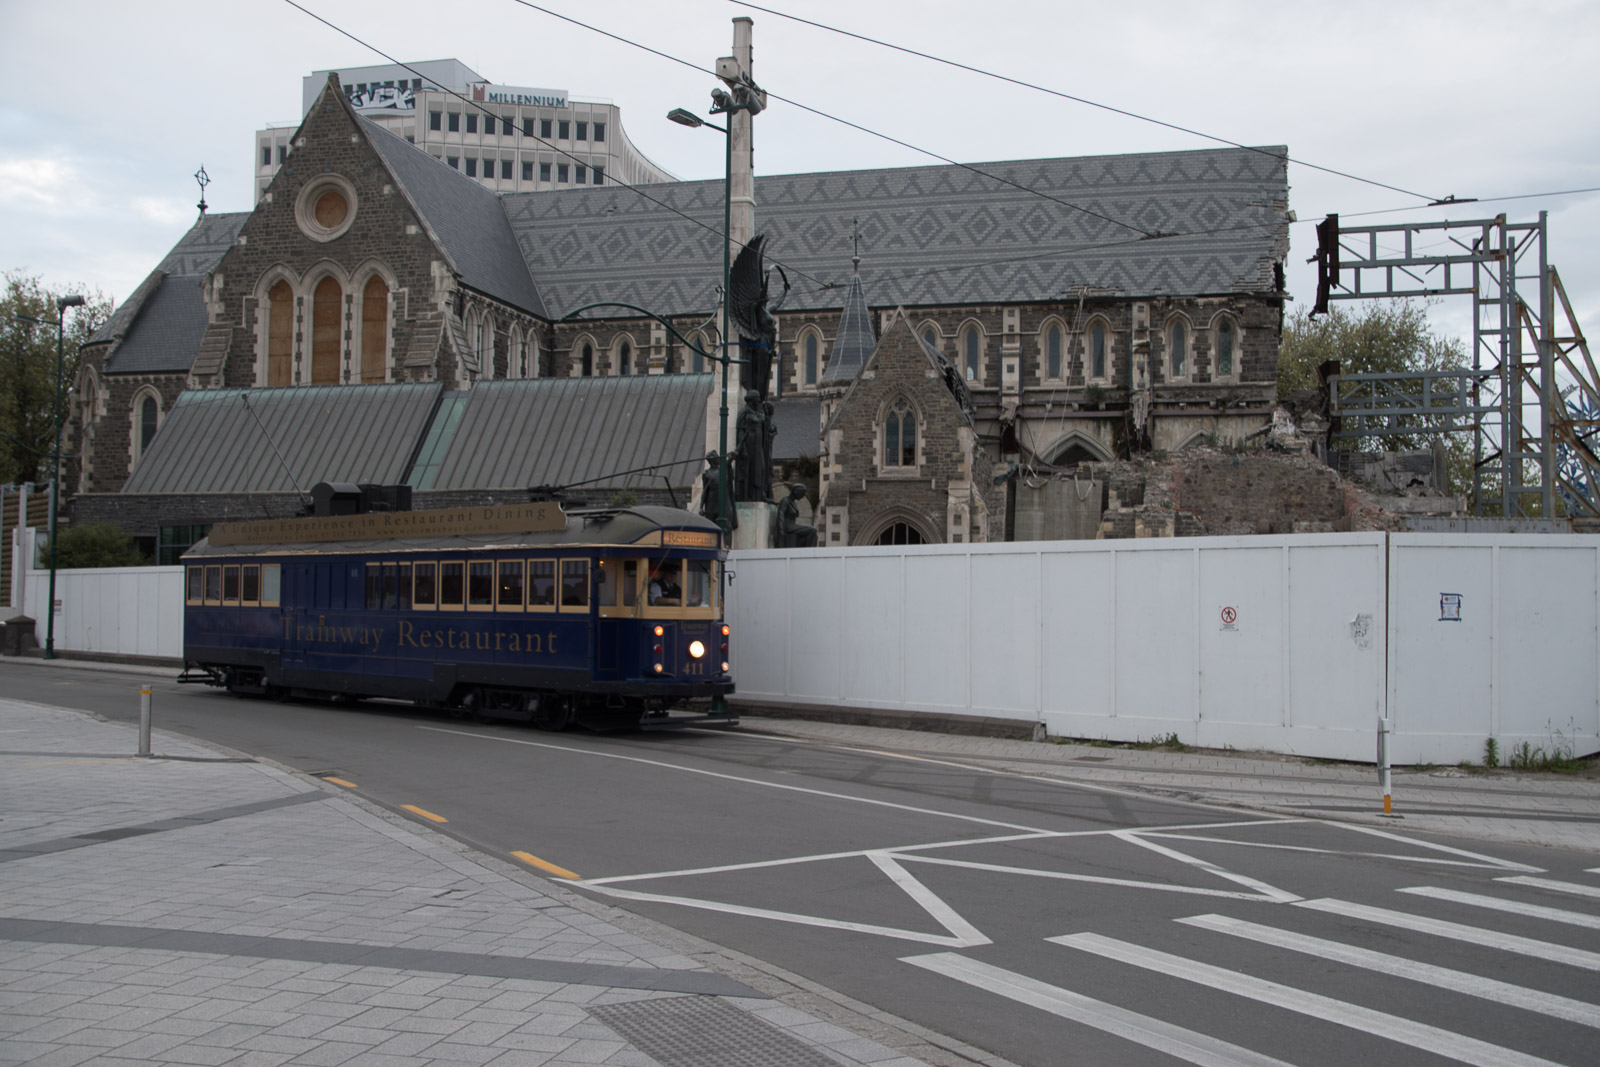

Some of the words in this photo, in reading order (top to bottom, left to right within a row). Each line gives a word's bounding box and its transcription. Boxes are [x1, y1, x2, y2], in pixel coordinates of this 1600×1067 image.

[488, 93, 565, 107] MILLENNIUM
[232, 523, 273, 537] Unique
[280, 517, 353, 536] Experience
[362, 518, 376, 528] in
[384, 510, 473, 526] Restaurant
[483, 506, 547, 520] Dining
[668, 532, 712, 545] Restaurant
[280, 617, 384, 653] Tramway
[397, 620, 558, 654] Restaurant
[682, 662, 704, 675] 411
